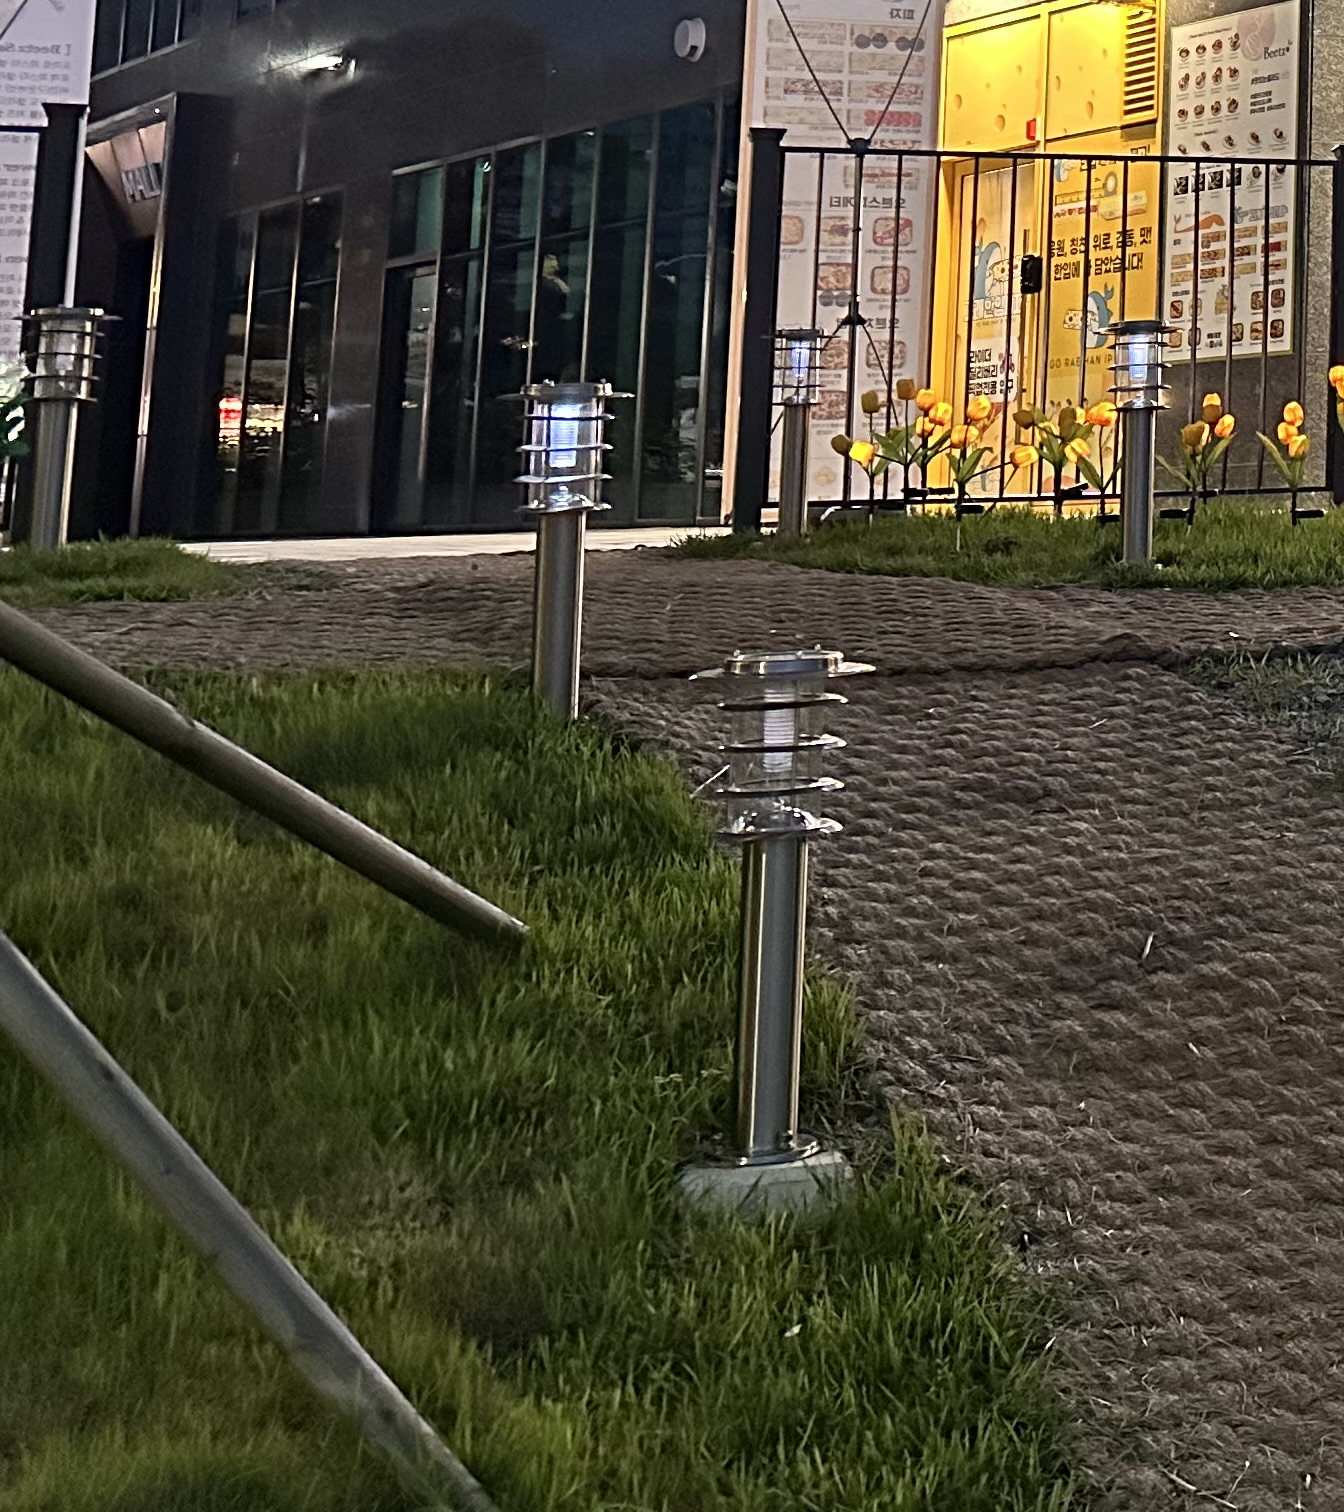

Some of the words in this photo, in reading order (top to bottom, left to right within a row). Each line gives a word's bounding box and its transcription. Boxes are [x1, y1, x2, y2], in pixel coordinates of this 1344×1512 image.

[1263, 46, 1286, 60] Beetz
[1049, 358, 1062, 369] GO
[1064, 356, 1081, 367] RAE
